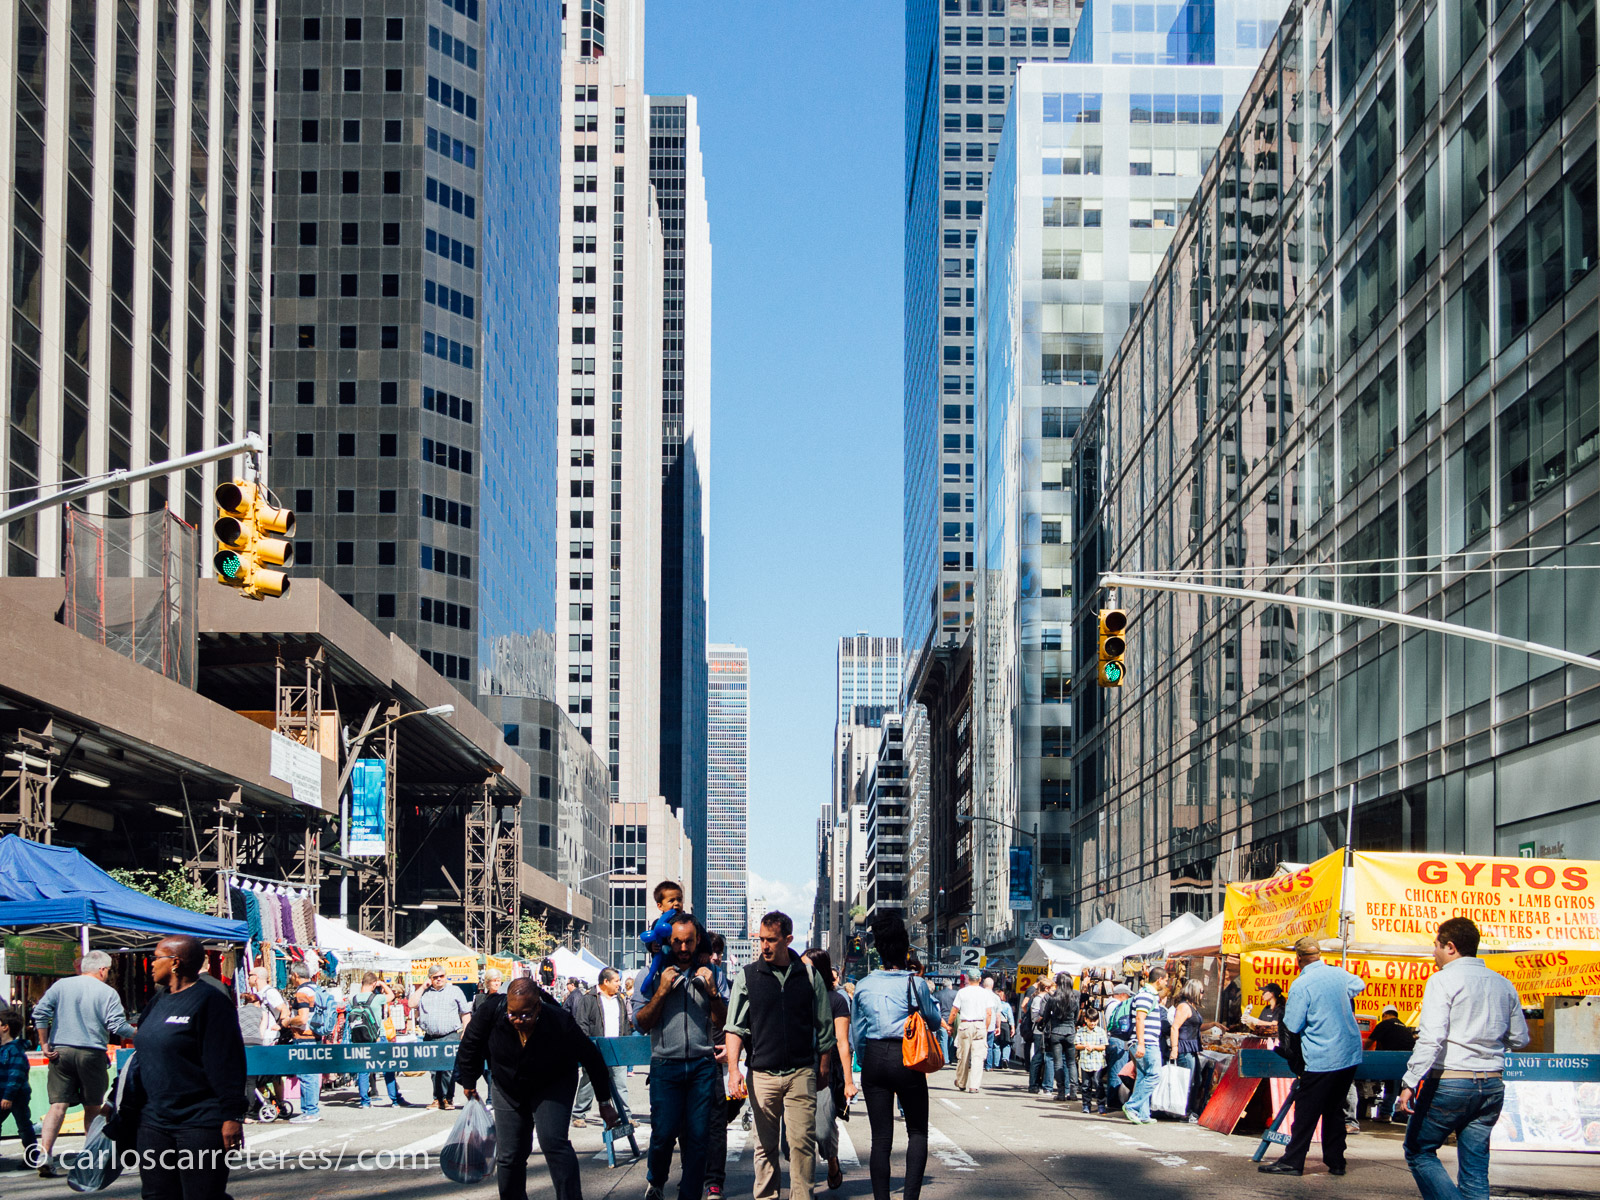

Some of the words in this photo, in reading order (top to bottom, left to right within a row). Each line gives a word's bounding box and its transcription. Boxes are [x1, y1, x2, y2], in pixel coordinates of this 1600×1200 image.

[1417, 860, 1589, 891] GYROS
[1241, 866, 1314, 902] GYROS
[1405, 888, 1458, 905] CHICKEN
[1461, 890, 1501, 906] GYROS
[1519, 893, 1551, 908] LAMB
[1554, 895, 1595, 909] GYROS
[1366, 902, 1396, 917] BEEF
[1400, 904, 1438, 919] KEBAB
[1452, 907, 1506, 923] CHICKEN
[1510, 910, 1551, 925] KEBAB
[1564, 912, 1598, 925] LAMB
[1371, 917, 1421, 934] SPECIAL
[1477, 923, 1532, 939] LATTERS
[449, 960, 471, 968] MIX
[1252, 956, 1302, 976] CHICK
[1514, 951, 1569, 969] GYROS
[1557, 965, 1579, 977] LAMB
[1579, 961, 1600, 974] GYRO
[1581, 974, 1600, 986] LA
[1357, 982, 1396, 997] ICKEN
[1400, 983, 1424, 998] KEB
[1356, 999, 1379, 1010] YROS
[289, 1047, 333, 1060] POLICE
[344, 1047, 371, 1059] LINE
[392, 1046, 408, 1058] DO
[414, 1045, 438, 1058] NOT
[366, 1060, 408, 1069] NYPD
[1518, 1057, 1541, 1068] NOT
[1547, 1058, 1589, 1069] CROSS
